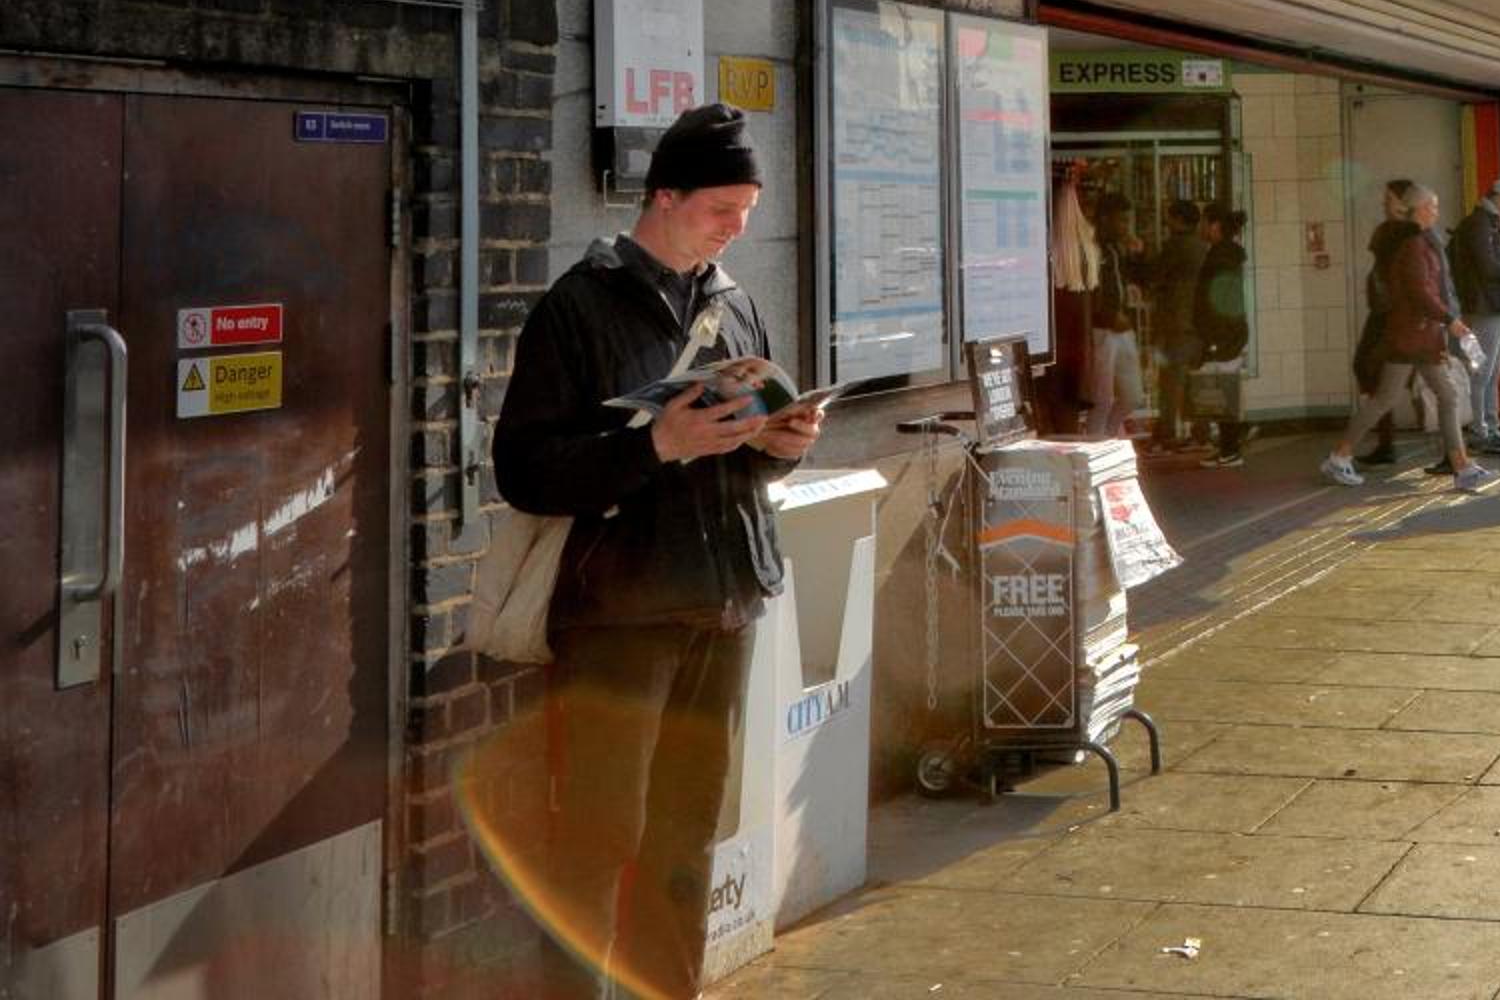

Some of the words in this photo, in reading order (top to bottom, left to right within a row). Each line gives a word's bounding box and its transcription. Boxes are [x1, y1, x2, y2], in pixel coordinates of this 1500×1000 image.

[1058, 62, 1176, 84] EXPRESS
[624, 66, 696, 117] LFB
[215, 315, 235, 331] No
[237, 314, 269, 332] entry
[214, 363, 273, 385] Danger
[992, 574, 1065, 605] FREE
[992, 604, 1025, 617] PLEASE
